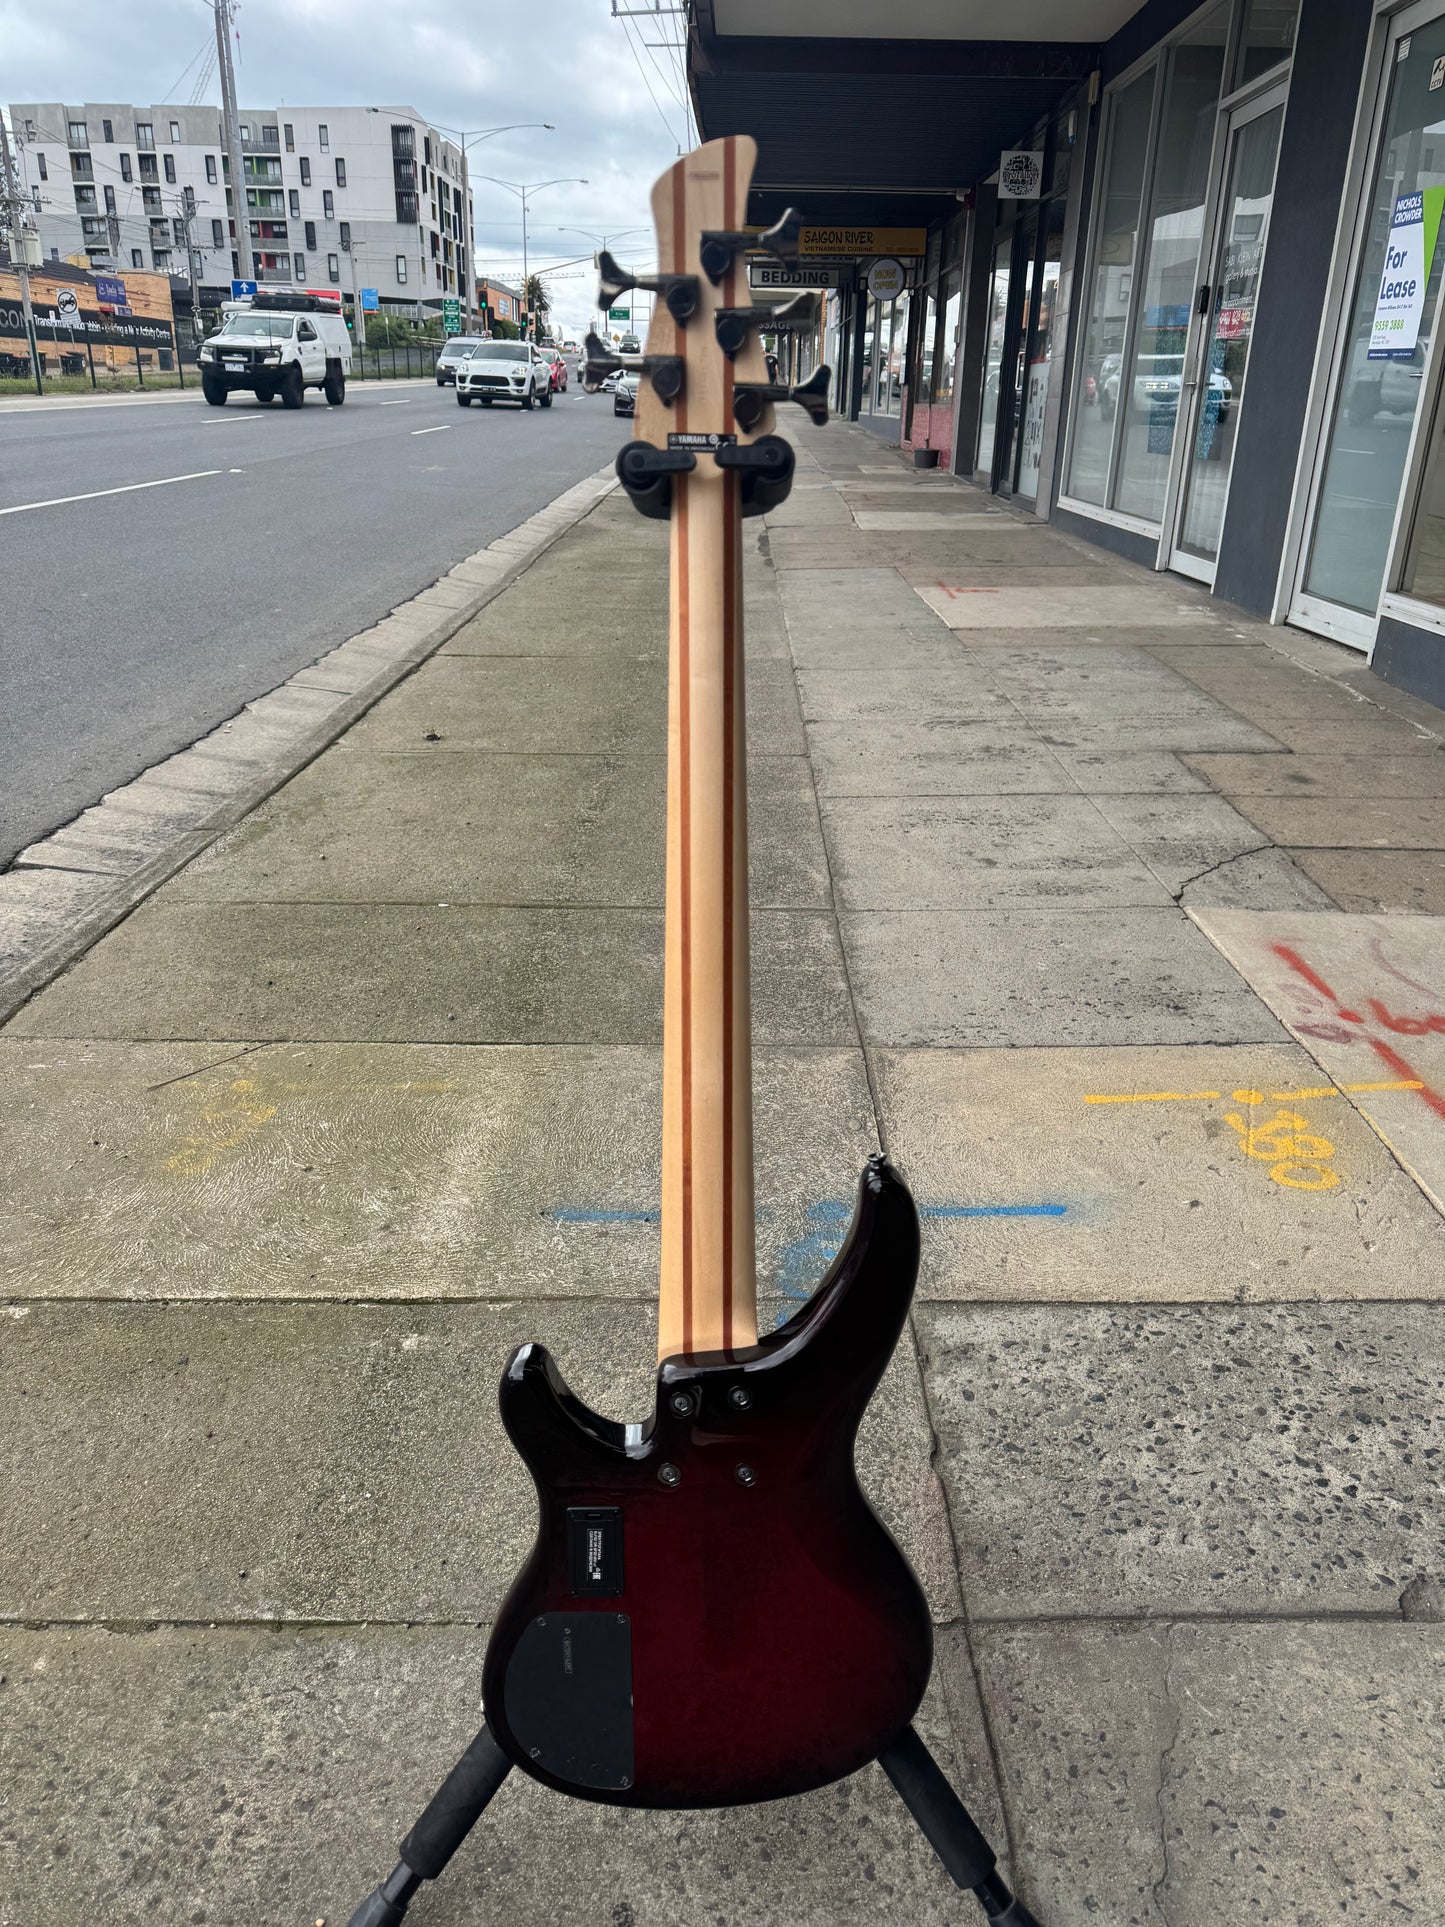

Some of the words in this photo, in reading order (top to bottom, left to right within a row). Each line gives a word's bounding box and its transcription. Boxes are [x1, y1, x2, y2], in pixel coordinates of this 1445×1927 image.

[1396, 195, 1422, 212] NICHOLS
[1394, 208, 1423, 224] CROWDER
[804, 231, 842, 244] SAIGON
[845, 231, 873, 244] RIVER
[1385, 246, 1408, 270] For
[761, 270, 830, 285] BEDDING
[874, 268, 897, 280] NOW
[873, 280, 898, 291] OPEN
[1380, 276, 1416, 300] Lease
[1374, 319, 1389, 331] 9559
[678, 435, 707, 444] YAMAHA
